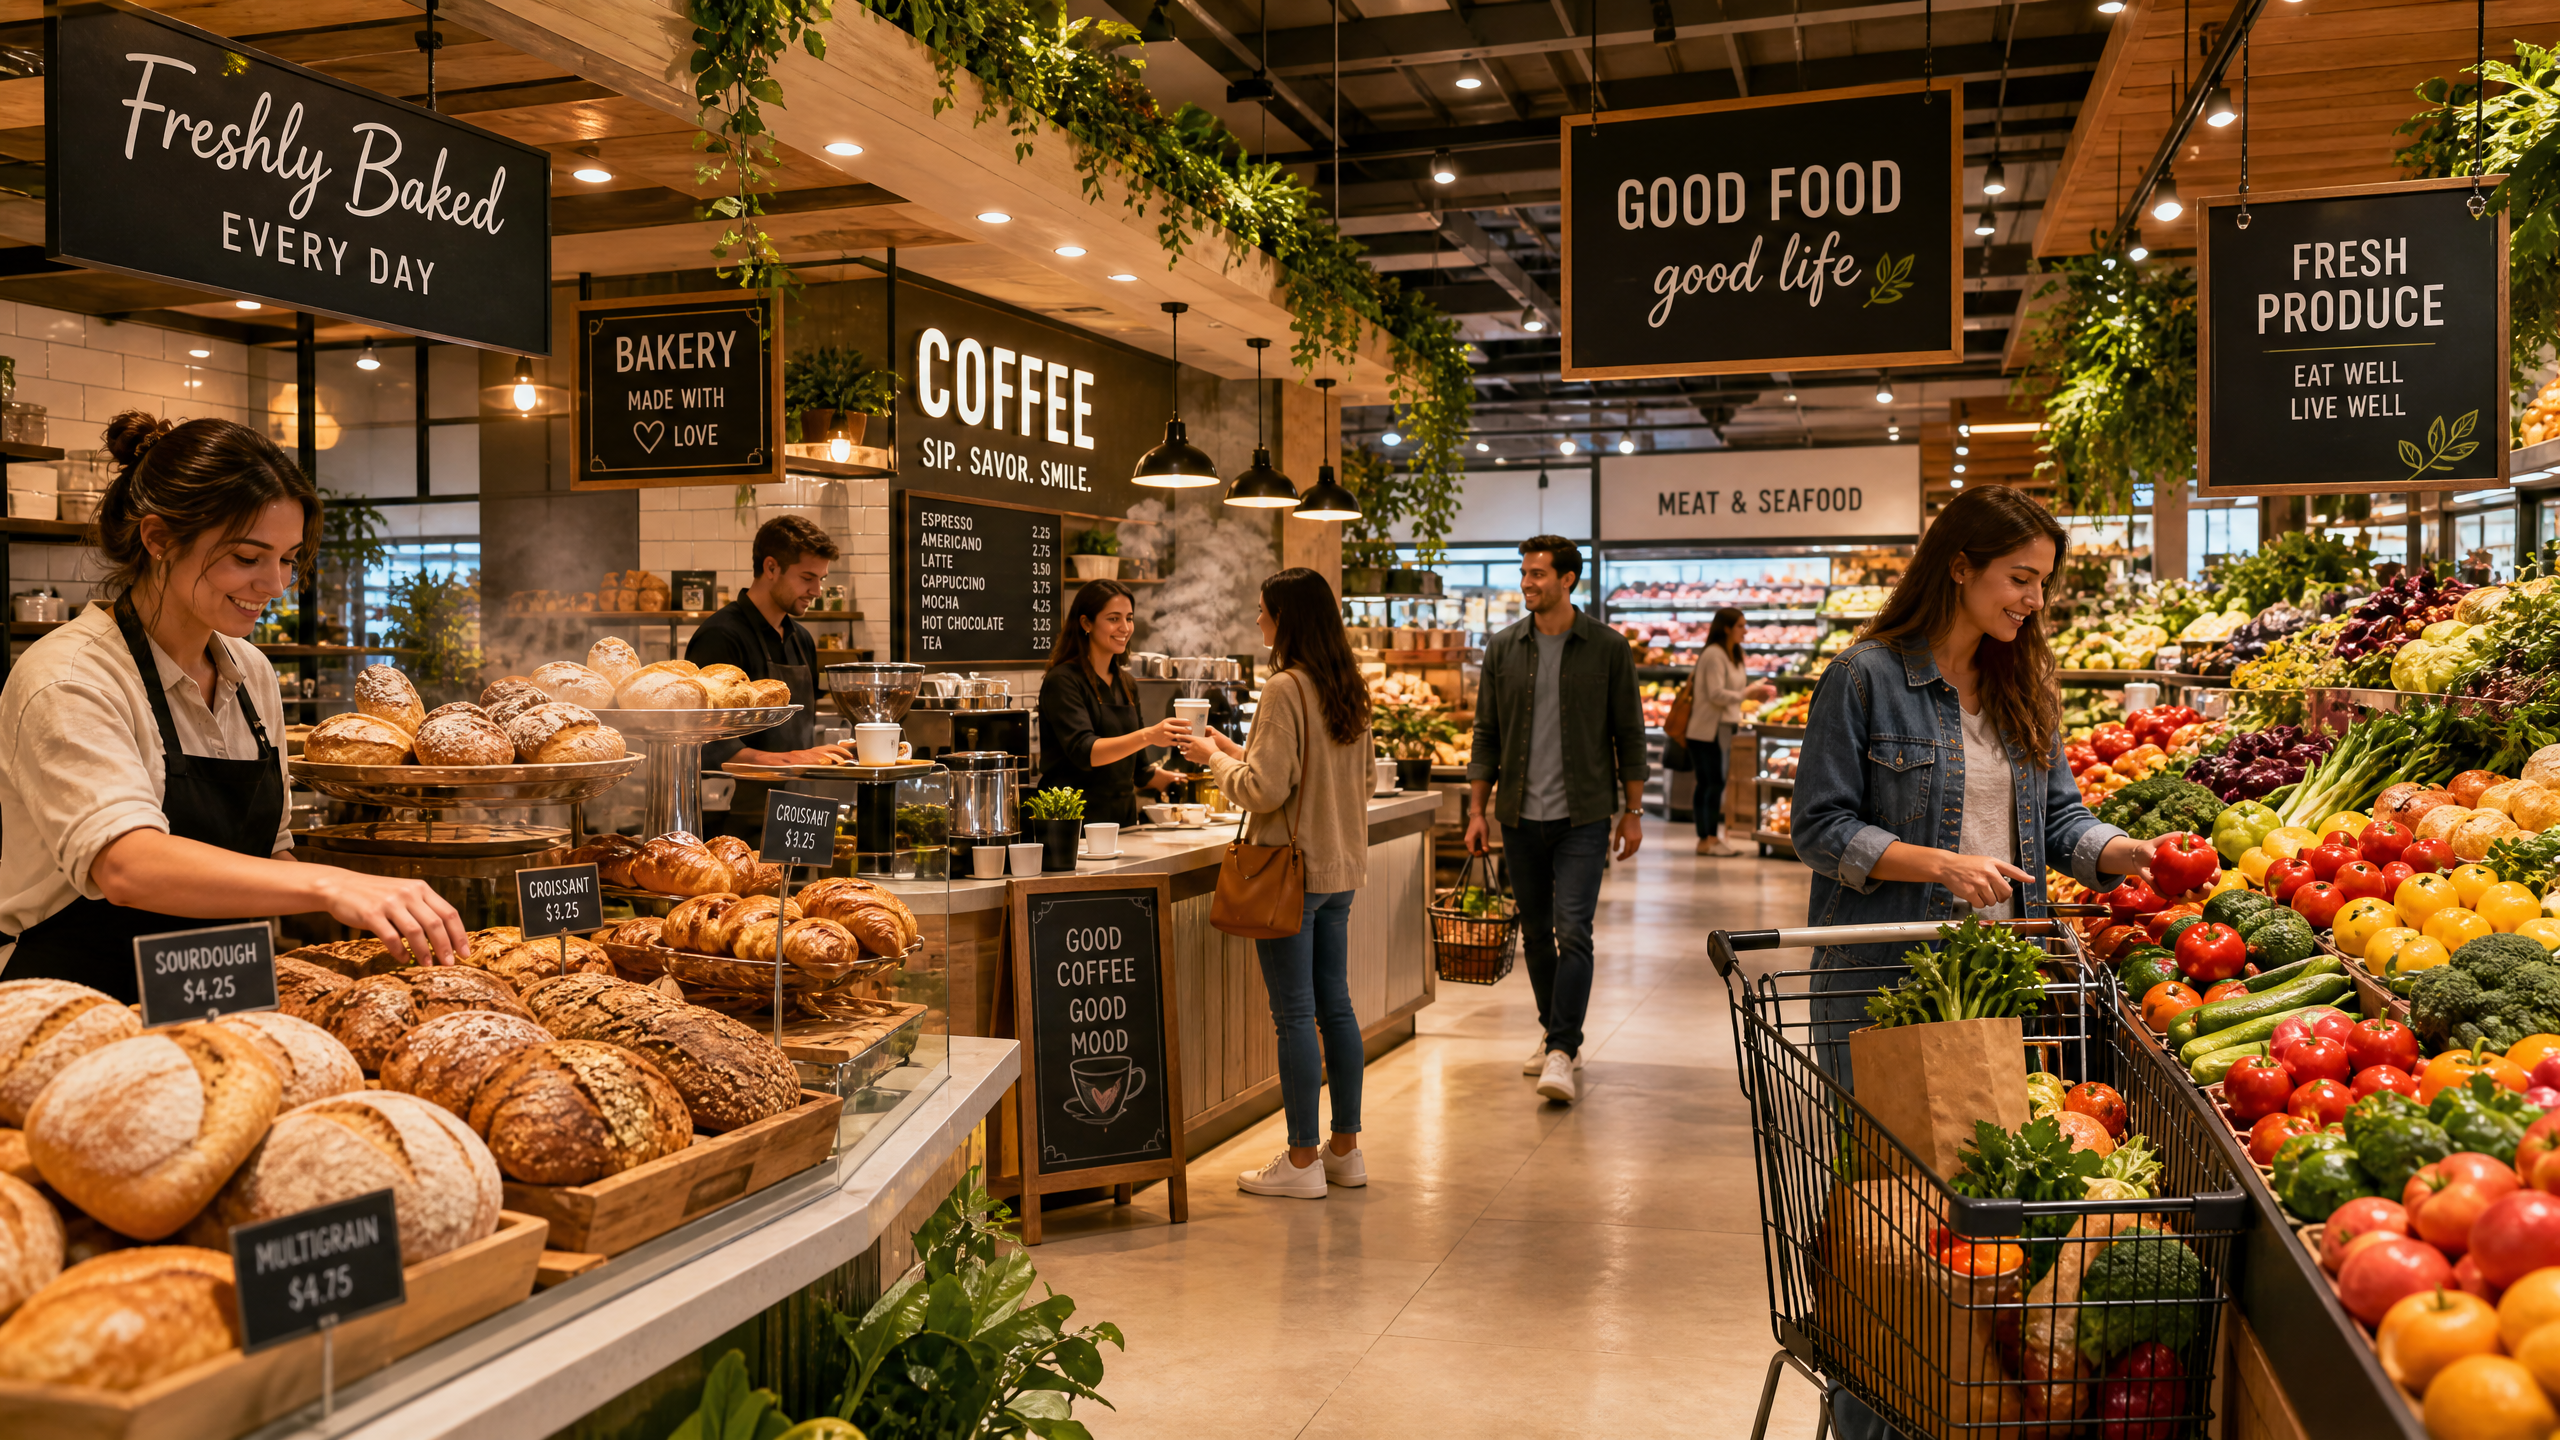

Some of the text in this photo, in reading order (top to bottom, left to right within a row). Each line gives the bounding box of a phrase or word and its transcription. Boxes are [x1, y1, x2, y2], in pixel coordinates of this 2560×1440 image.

[122, 53, 506, 234] Freshly Baked
[1618, 160, 1900, 230] GOOD FOOD
[223, 211, 434, 295] EVERY DAY
[2294, 237, 2406, 280] FRESH
[1648, 231, 1861, 328] good life
[2259, 284, 2443, 334] PRODUCE
[617, 331, 736, 372] BAKERY
[2295, 361, 2403, 387] EAT WELL
[629, 387, 723, 410] MADE WITH
[919, 327, 1094, 450] COFFEE
[2292, 394, 2406, 420] LIVE WELL
[675, 424, 718, 446] LOVE
[923, 438, 1091, 492] SIP. SAVOR. SMILE.
[1659, 487, 1861, 515] MEAT & SEAFOOD
[922, 512, 1050, 539] ESPRESSO 2.25
[921, 533, 1050, 557] AMERICANO 2.75
[922, 553, 1050, 575] LATTE 3.50
[922, 574, 1050, 593] CAPPUCCINO 3.75
[922, 595, 1050, 612] MOCHA 4.25
[922, 616, 1050, 631] HOT CHOCOLATE 3.25
[922, 636, 1050, 649] TEA 2.25
[786, 829, 815, 849] $3.25
[530, 877, 589, 898] CROISSANT
[546, 902, 579, 922] $3.25
[1067, 927, 1121, 952] GOOD
[155, 942, 256, 975] SOURDOUGH
[1058, 958, 1135, 986] COFFEE
[184, 975, 235, 1003] $4.25
[1070, 996, 1126, 1022] GOOD
[1072, 1029, 1128, 1056] MOOD
[255, 1214, 378, 1276] MULTIGRAIN
[288, 1264, 353, 1312] $4.75
